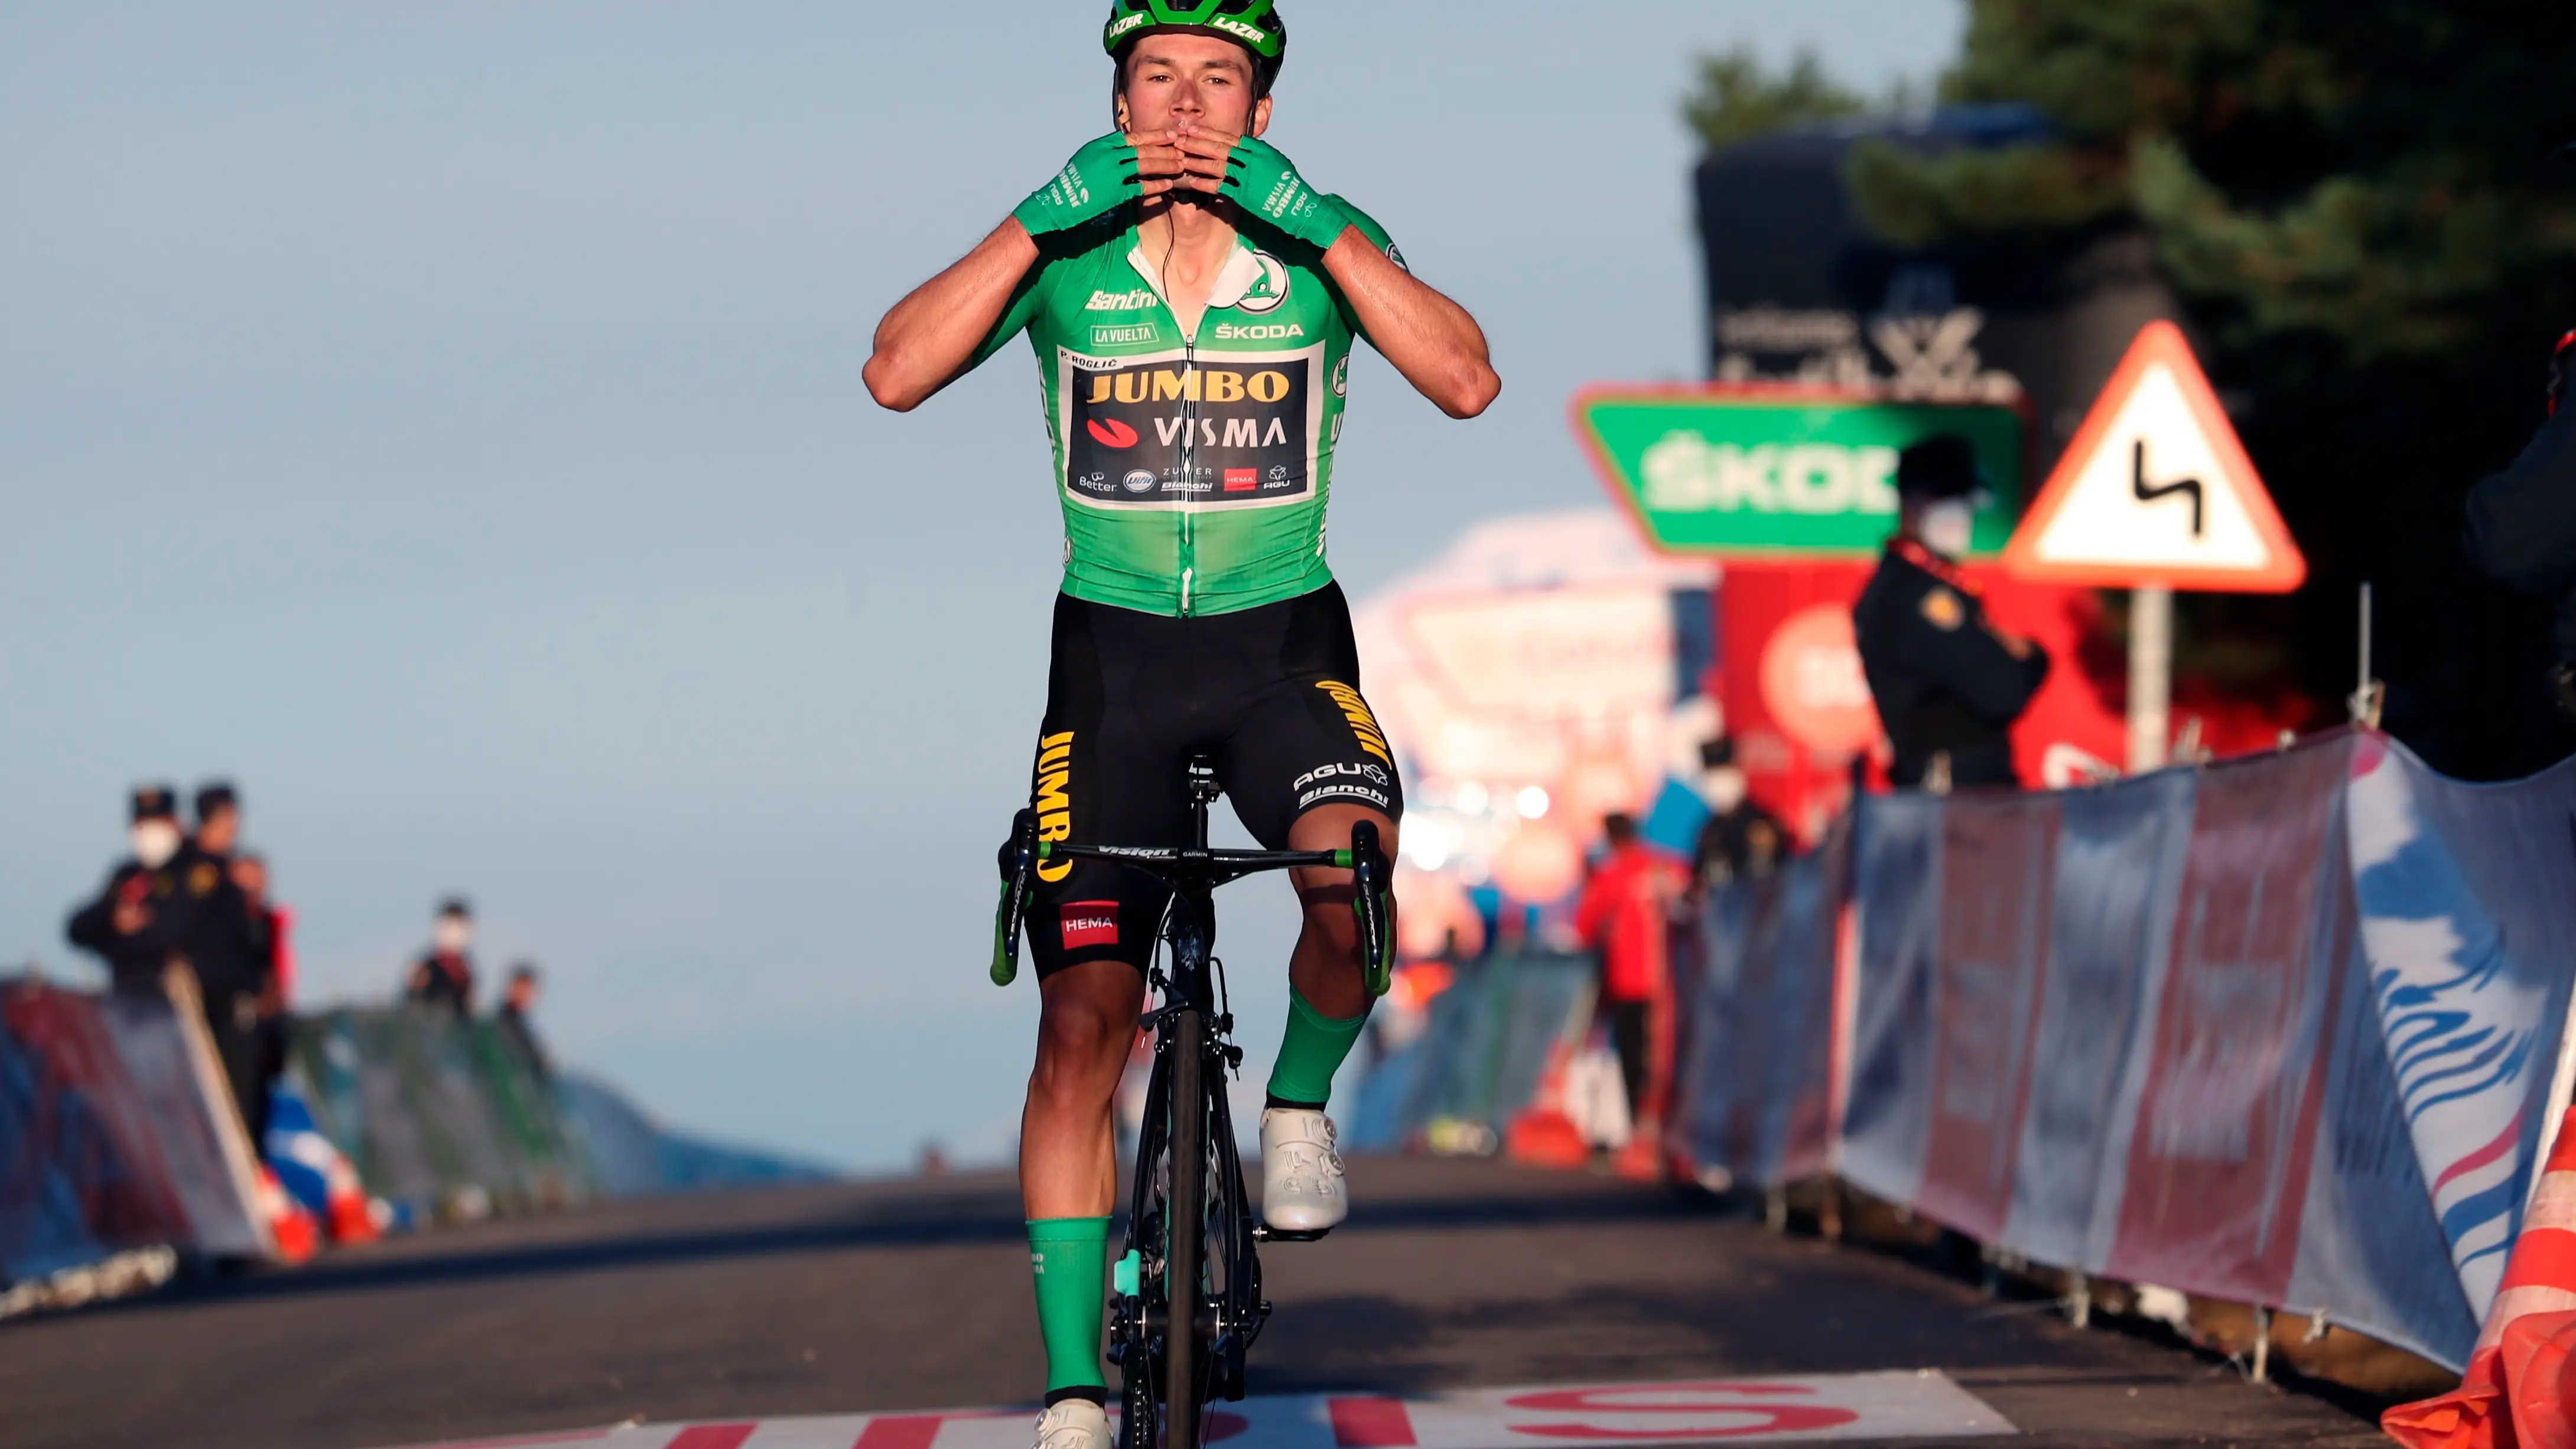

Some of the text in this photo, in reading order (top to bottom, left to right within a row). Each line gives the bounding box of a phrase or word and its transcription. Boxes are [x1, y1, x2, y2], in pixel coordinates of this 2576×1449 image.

[1109, 13, 1143, 38] LAZER
[1214, 17, 1265, 43] LAZER
[1261, 181, 1286, 211] VISMA
[1272, 175, 1300, 218] JUMBO
[1291, 191, 1307, 216] AGU
[1084, 288, 1159, 310] Santini
[1095, 327, 1152, 342] LA VUELTA
[1215, 323, 1305, 339] ŠKODA
[1086, 369, 1290, 403] JUMBO
[1154, 416, 1287, 448] VISMA
[1641, 429, 1901, 512] ŠKOD
[1079, 476, 1116, 492] Better
[1263, 480, 1290, 490] AGU
[1315, 680, 1392, 771] JUMBO
[1293, 763, 1361, 792] AGU
[1299, 784, 1389, 807] Bianchi
[1065, 916, 1113, 932] HEMA
